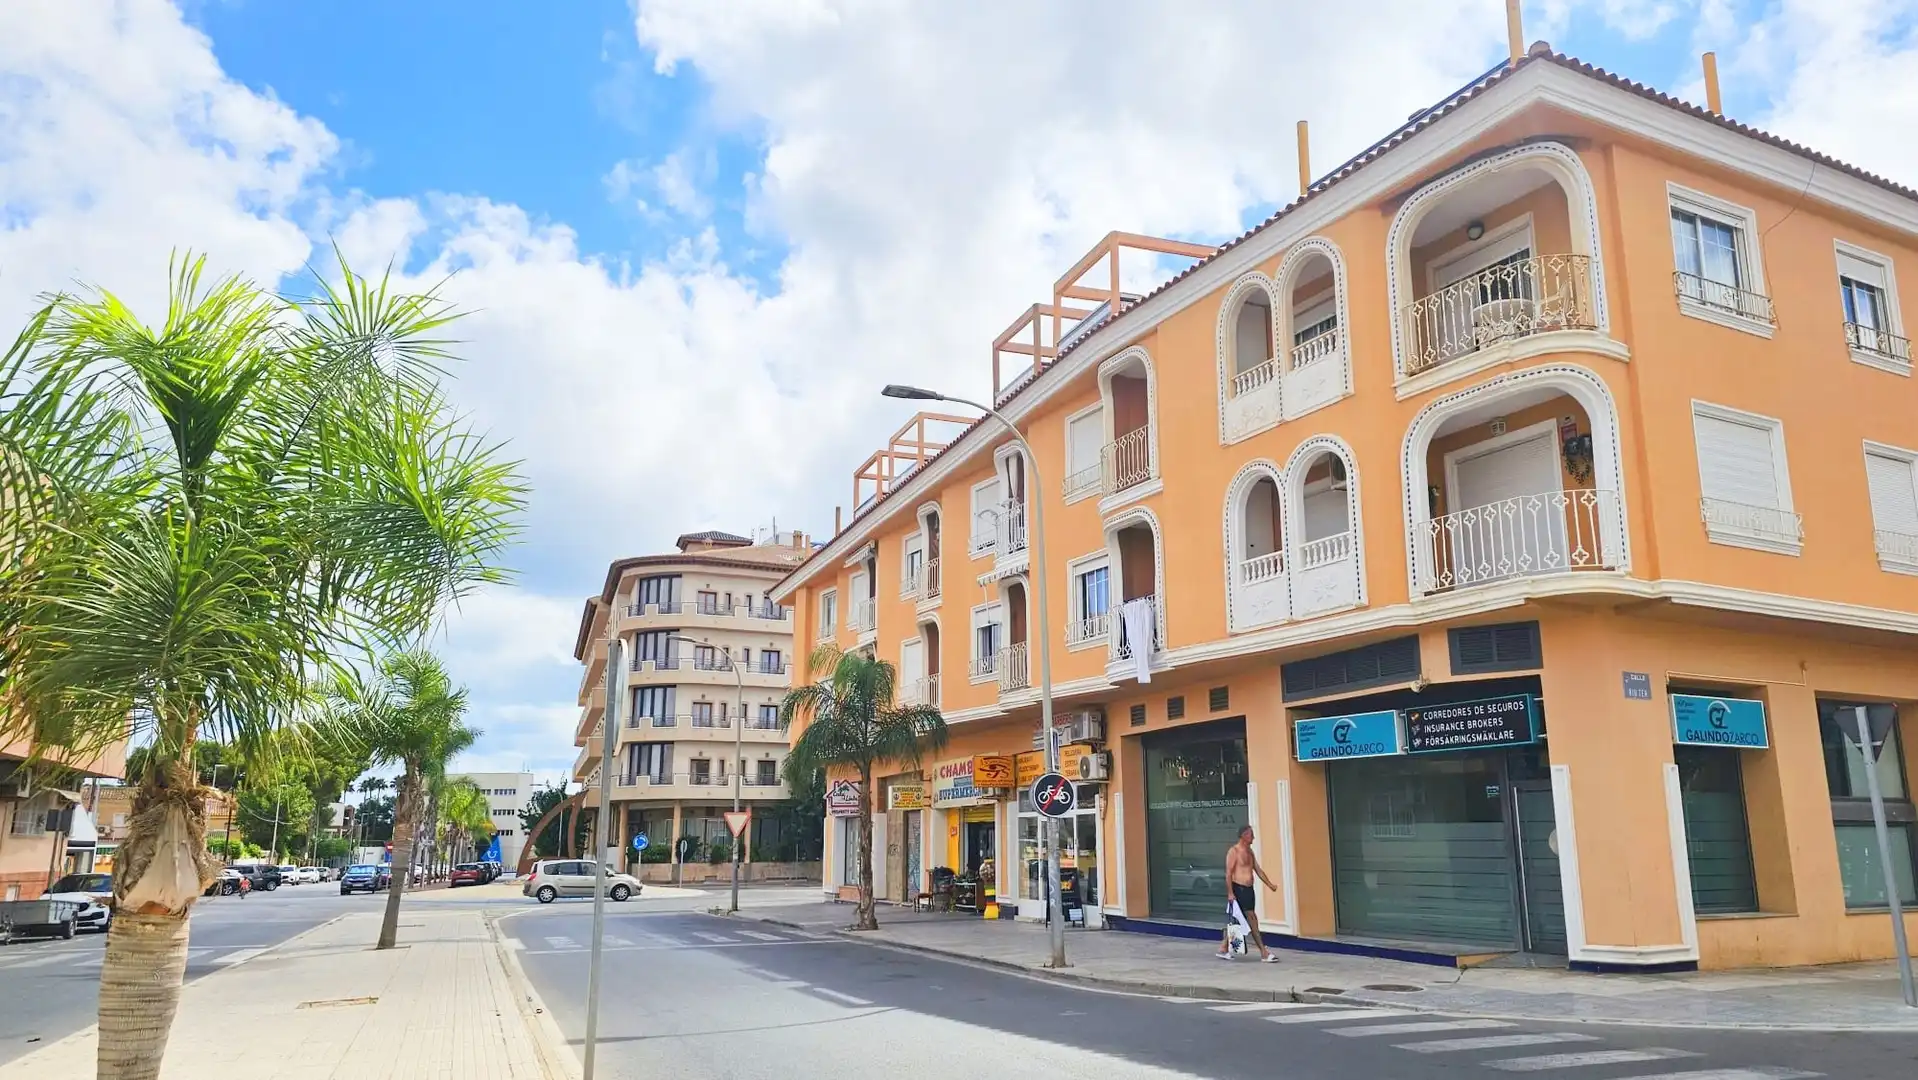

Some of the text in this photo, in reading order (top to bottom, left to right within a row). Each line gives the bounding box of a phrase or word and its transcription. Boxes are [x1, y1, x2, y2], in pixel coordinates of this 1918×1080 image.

[1423, 700, 1525, 721] CORREDORES DE SEGUROS
[1424, 717, 1504, 734] INSURANCE BROKERS
[1425, 729, 1515, 747] FÖRSÄKRINGSMÄKLARE
[1686, 729, 1759, 745] GALINDOZARCO
[1311, 742, 1385, 758] GALINDOZARCO
[940, 759, 973, 778] CHAMB
